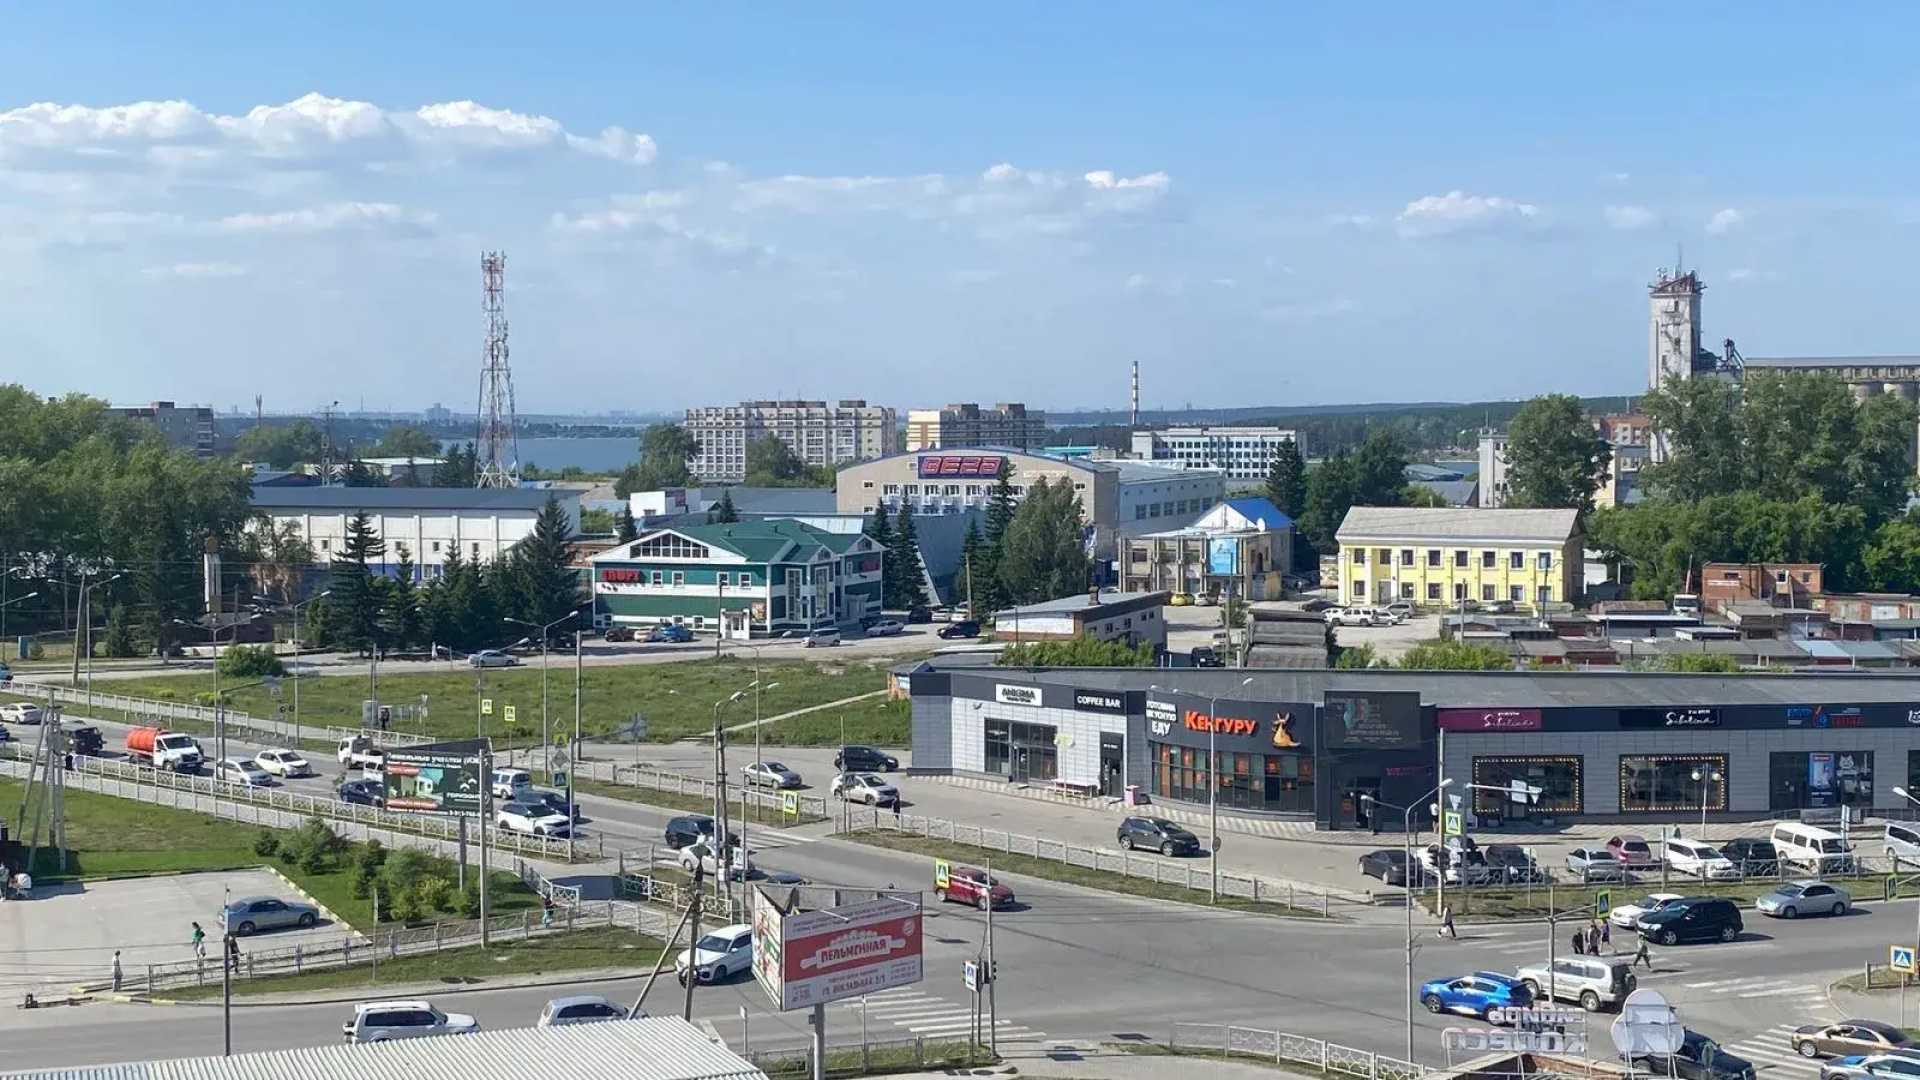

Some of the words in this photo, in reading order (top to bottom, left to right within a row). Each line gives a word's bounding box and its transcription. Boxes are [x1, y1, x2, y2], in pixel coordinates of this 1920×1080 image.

[1076, 695, 1104, 707] COFFEE
[1105, 697, 1121, 709] BAR
[1152, 722, 1171, 736] ЕДУ
[821, 938, 887, 964] ПЕЛЬМЕННАЯ
